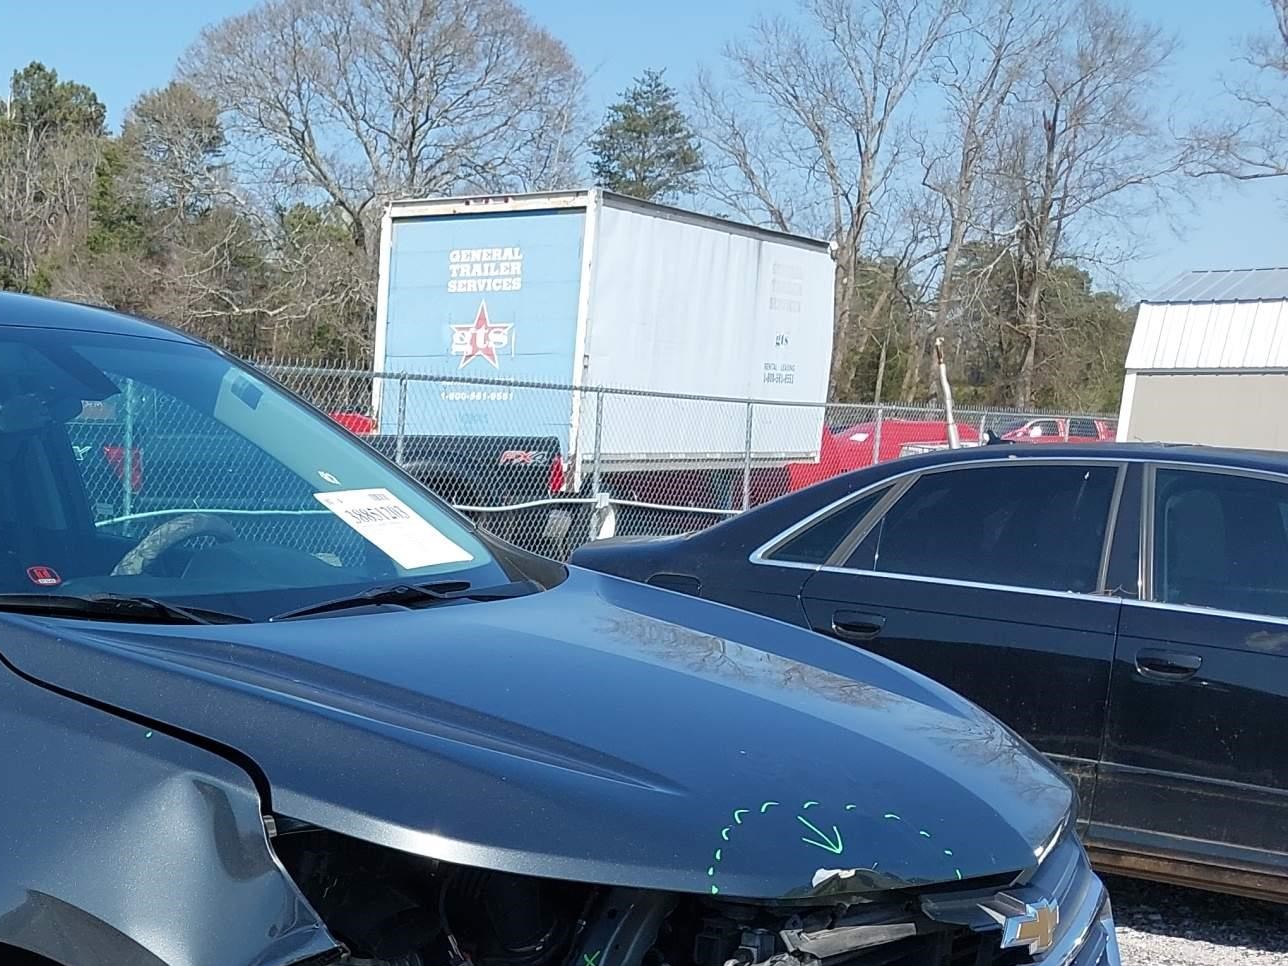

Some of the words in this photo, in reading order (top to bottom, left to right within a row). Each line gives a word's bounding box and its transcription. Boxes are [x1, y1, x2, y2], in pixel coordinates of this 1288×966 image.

[449, 247, 523, 263] GENERAL
[449, 262, 522, 277] TRAILER
[448, 277, 522, 293] SERVICES
[452, 325, 508, 356] gts
[344, 505, 410, 524] 38851203
